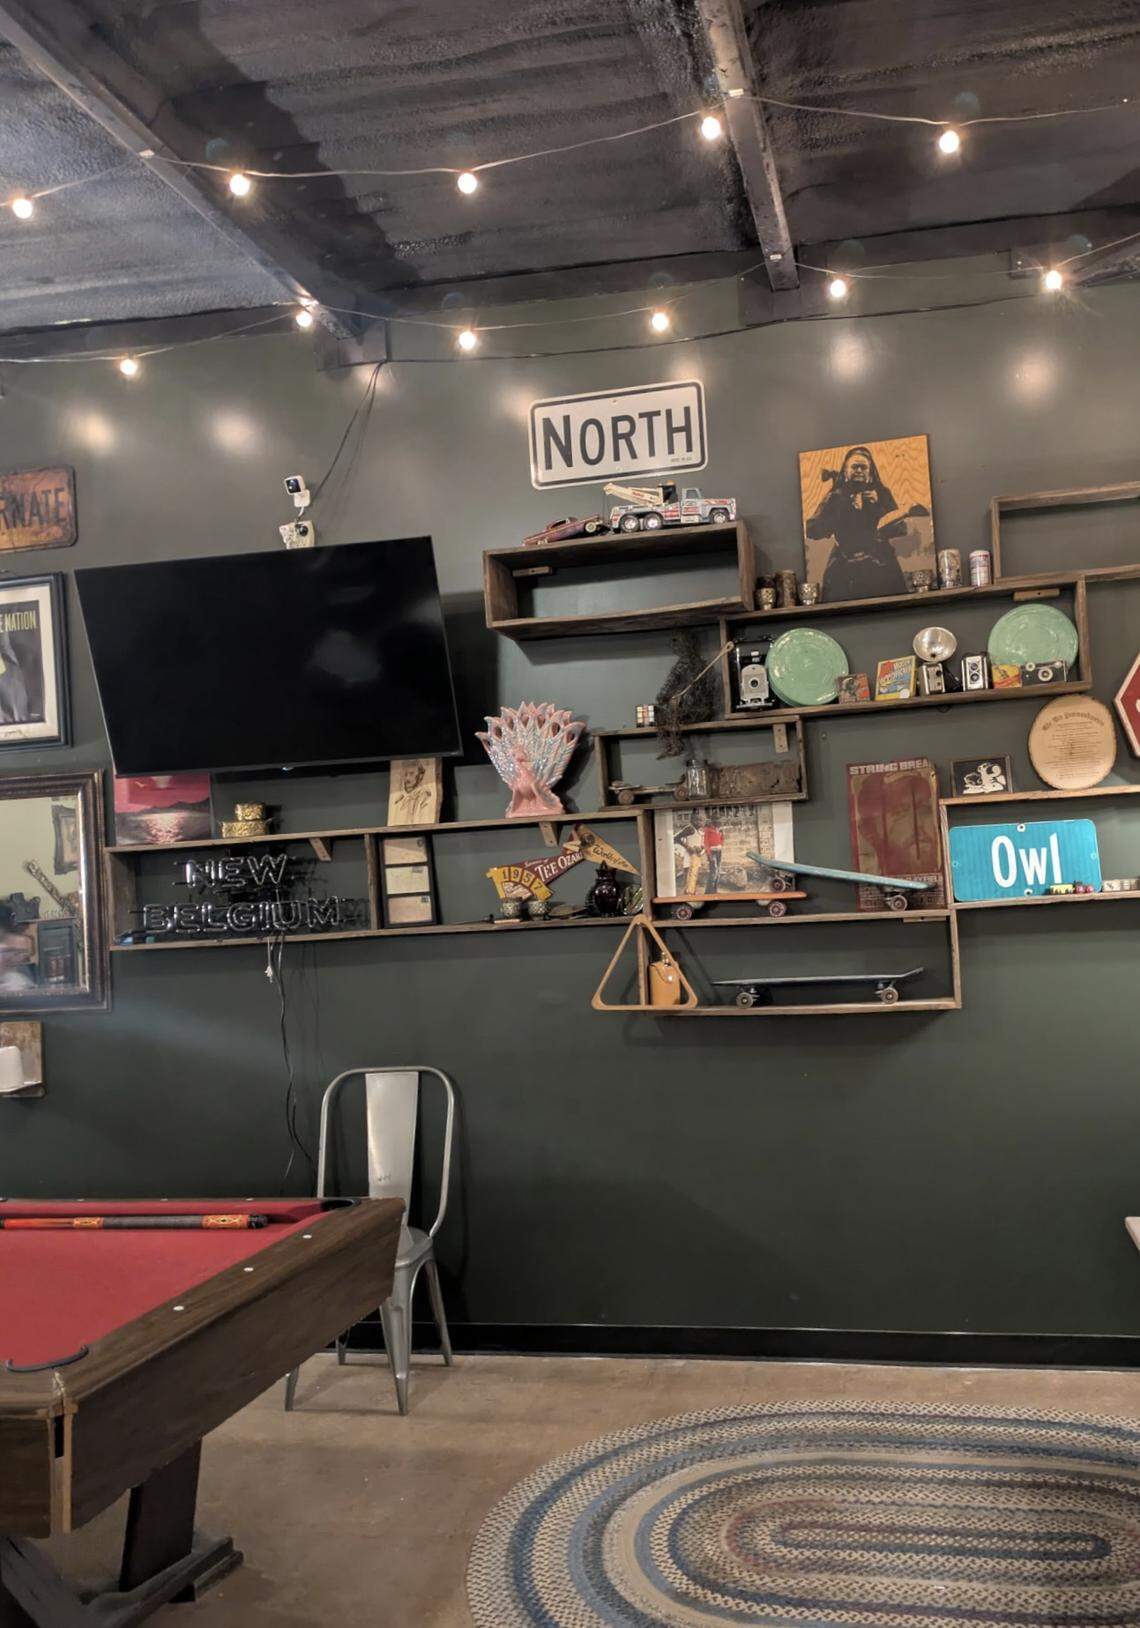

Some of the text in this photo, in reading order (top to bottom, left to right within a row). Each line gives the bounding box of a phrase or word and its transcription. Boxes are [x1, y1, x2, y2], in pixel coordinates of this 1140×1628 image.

[543, 406, 693, 470] NORTH
[4, 610, 37, 632] NATION
[184, 854, 288, 888] NEW
[991, 833, 1062, 888] Owl
[143, 896, 341, 933] BELGIUM
